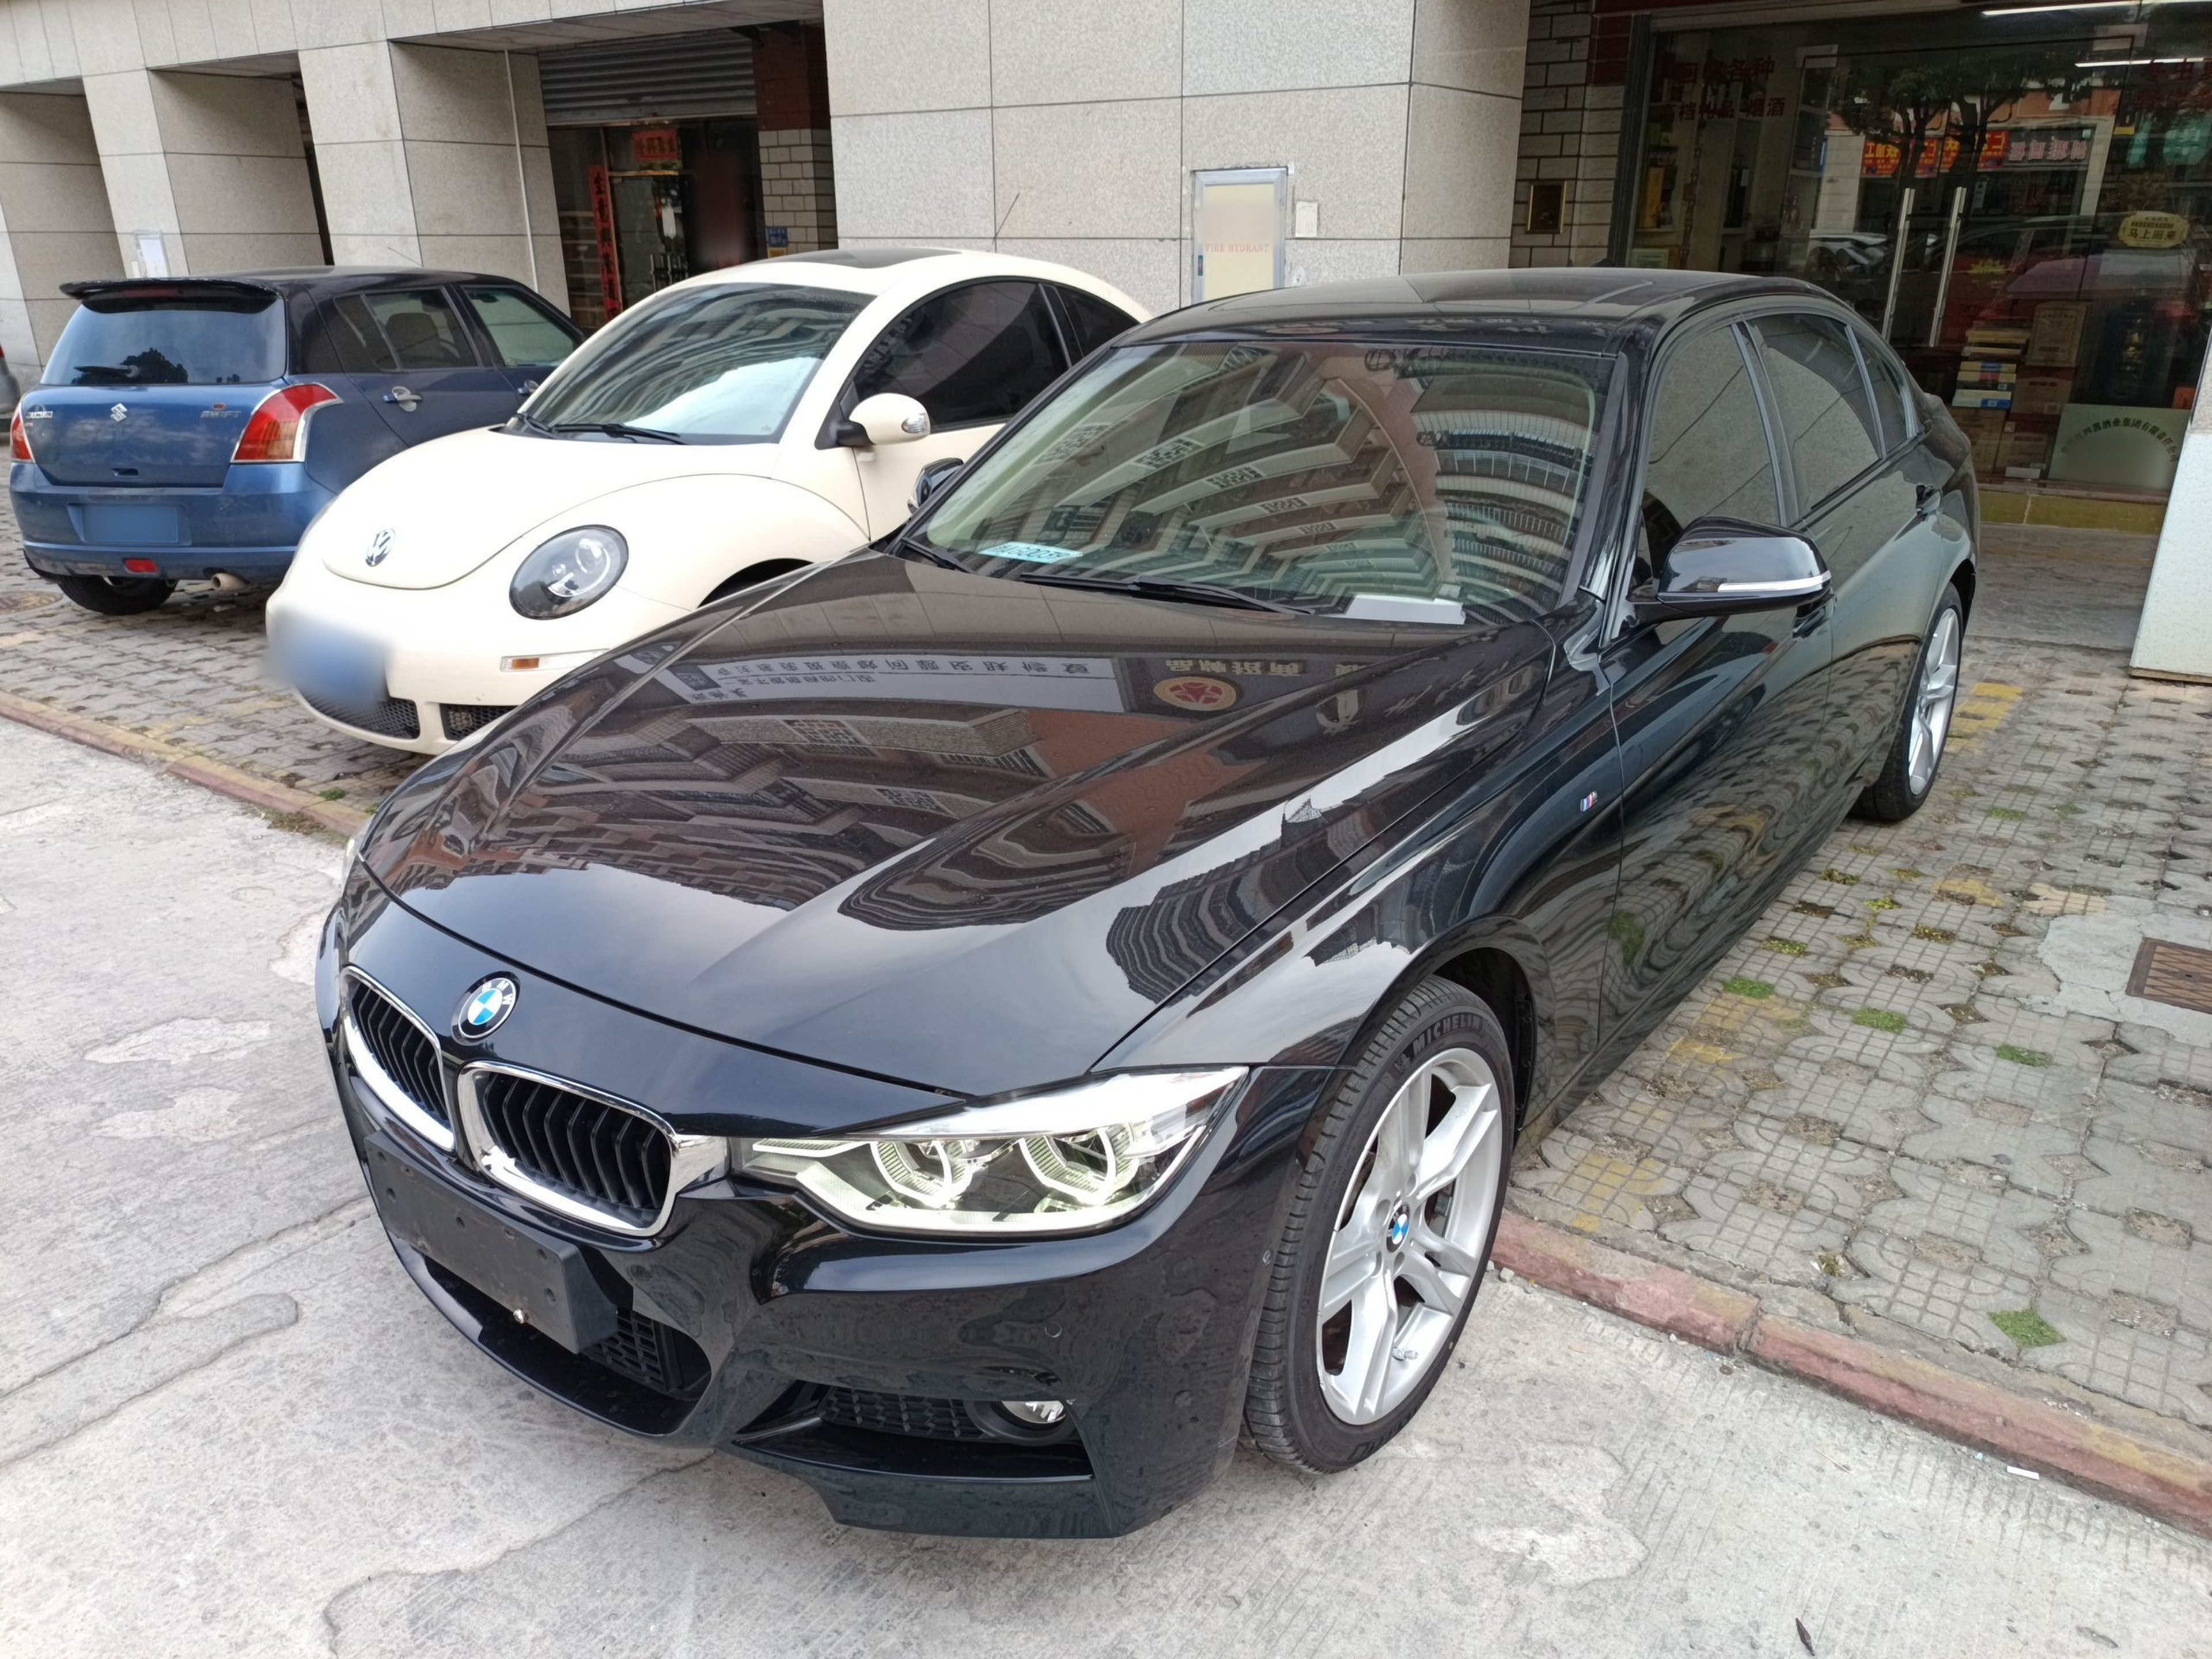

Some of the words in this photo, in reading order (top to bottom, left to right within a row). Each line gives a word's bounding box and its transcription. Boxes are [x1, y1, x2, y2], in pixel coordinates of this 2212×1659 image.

[1228, 243, 1269, 252] HYDRANT
[482, 980, 514, 1005] BMW
[1412, 1013, 1482, 1057] MICHELIN
